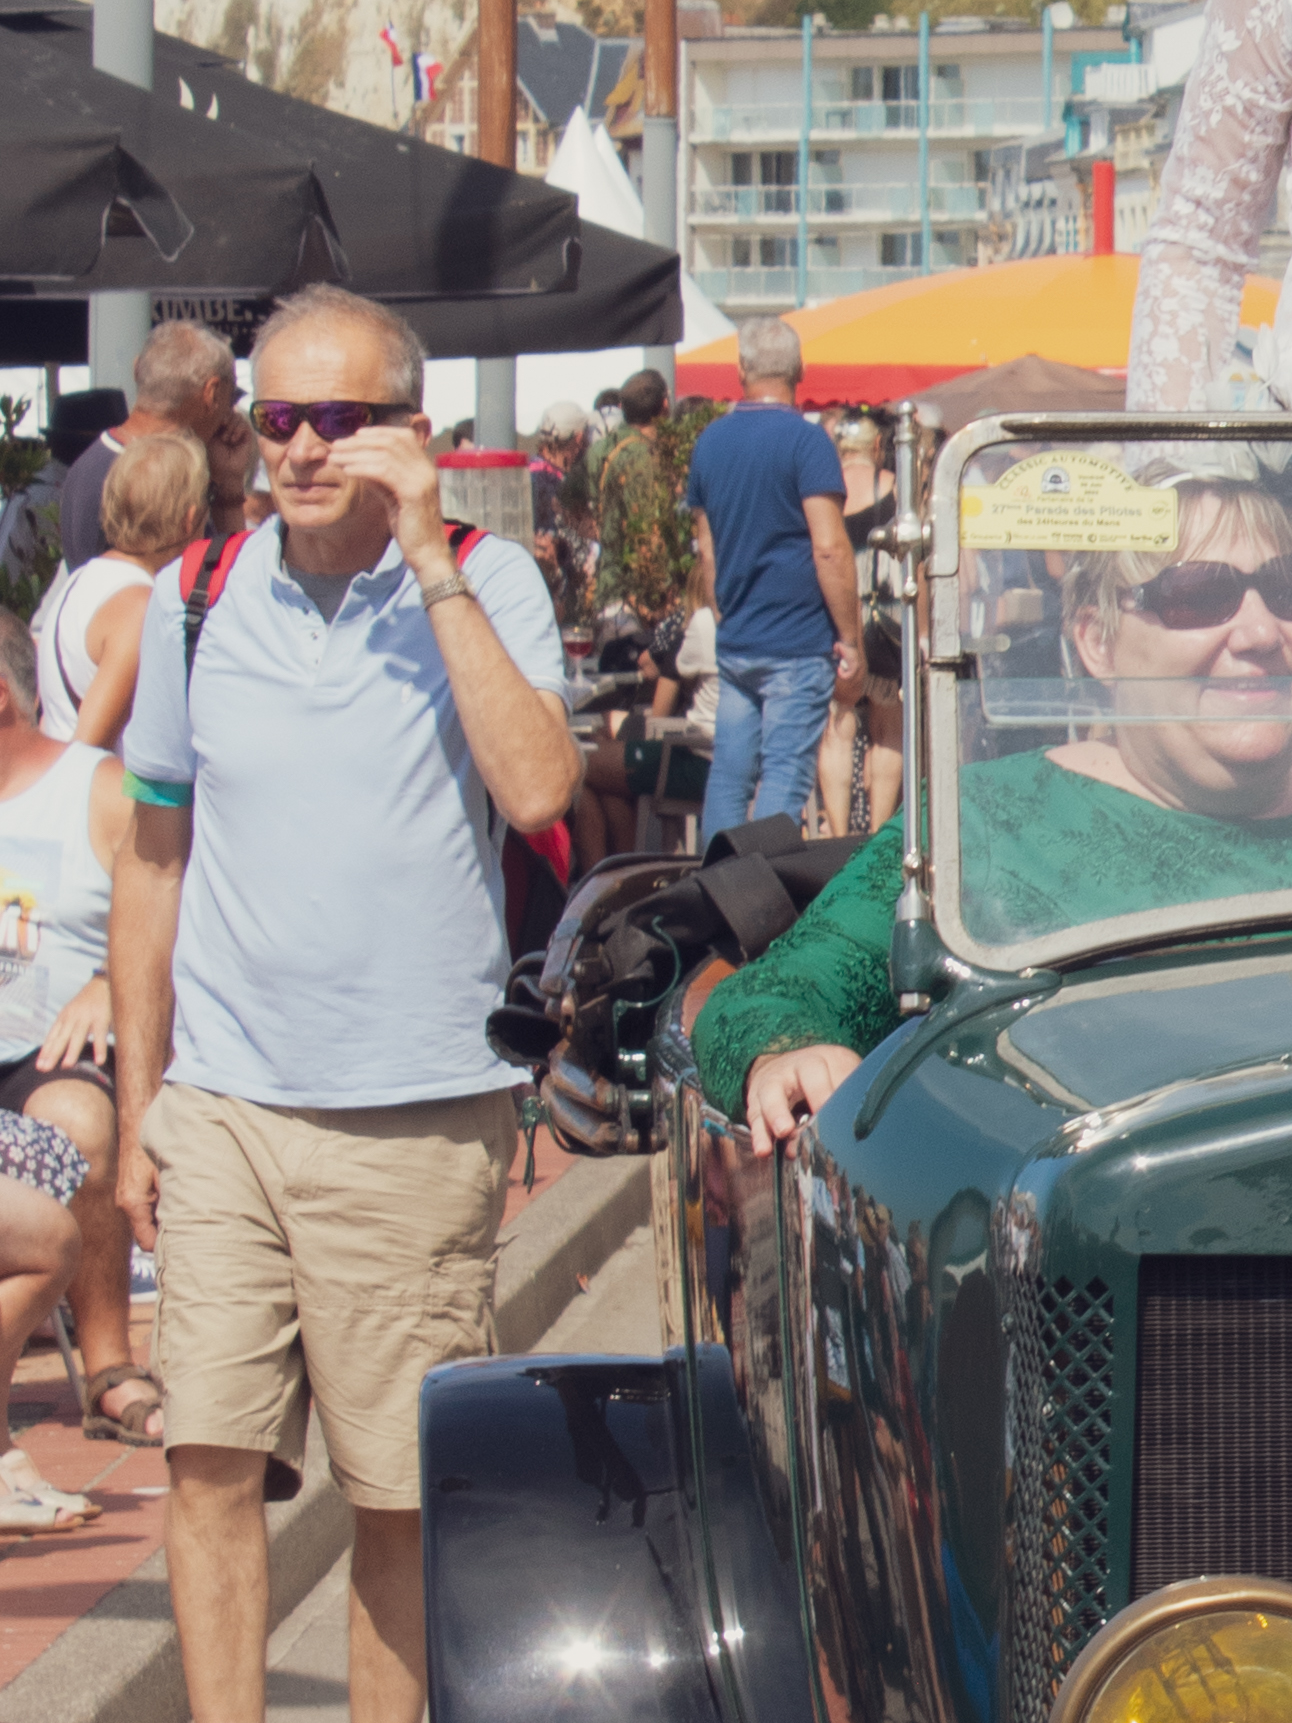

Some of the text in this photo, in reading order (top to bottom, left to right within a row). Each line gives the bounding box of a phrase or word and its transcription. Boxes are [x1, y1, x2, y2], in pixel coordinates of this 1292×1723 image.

[1000, 455, 1133, 492] CLASSIC AUTOMOTIVE
[1025, 504, 1069, 516] Parade
[1073, 505, 1096, 517] des
[1100, 505, 1143, 517] Pilotes
[1017, 517, 1121, 527] des 24Heures du Mans
